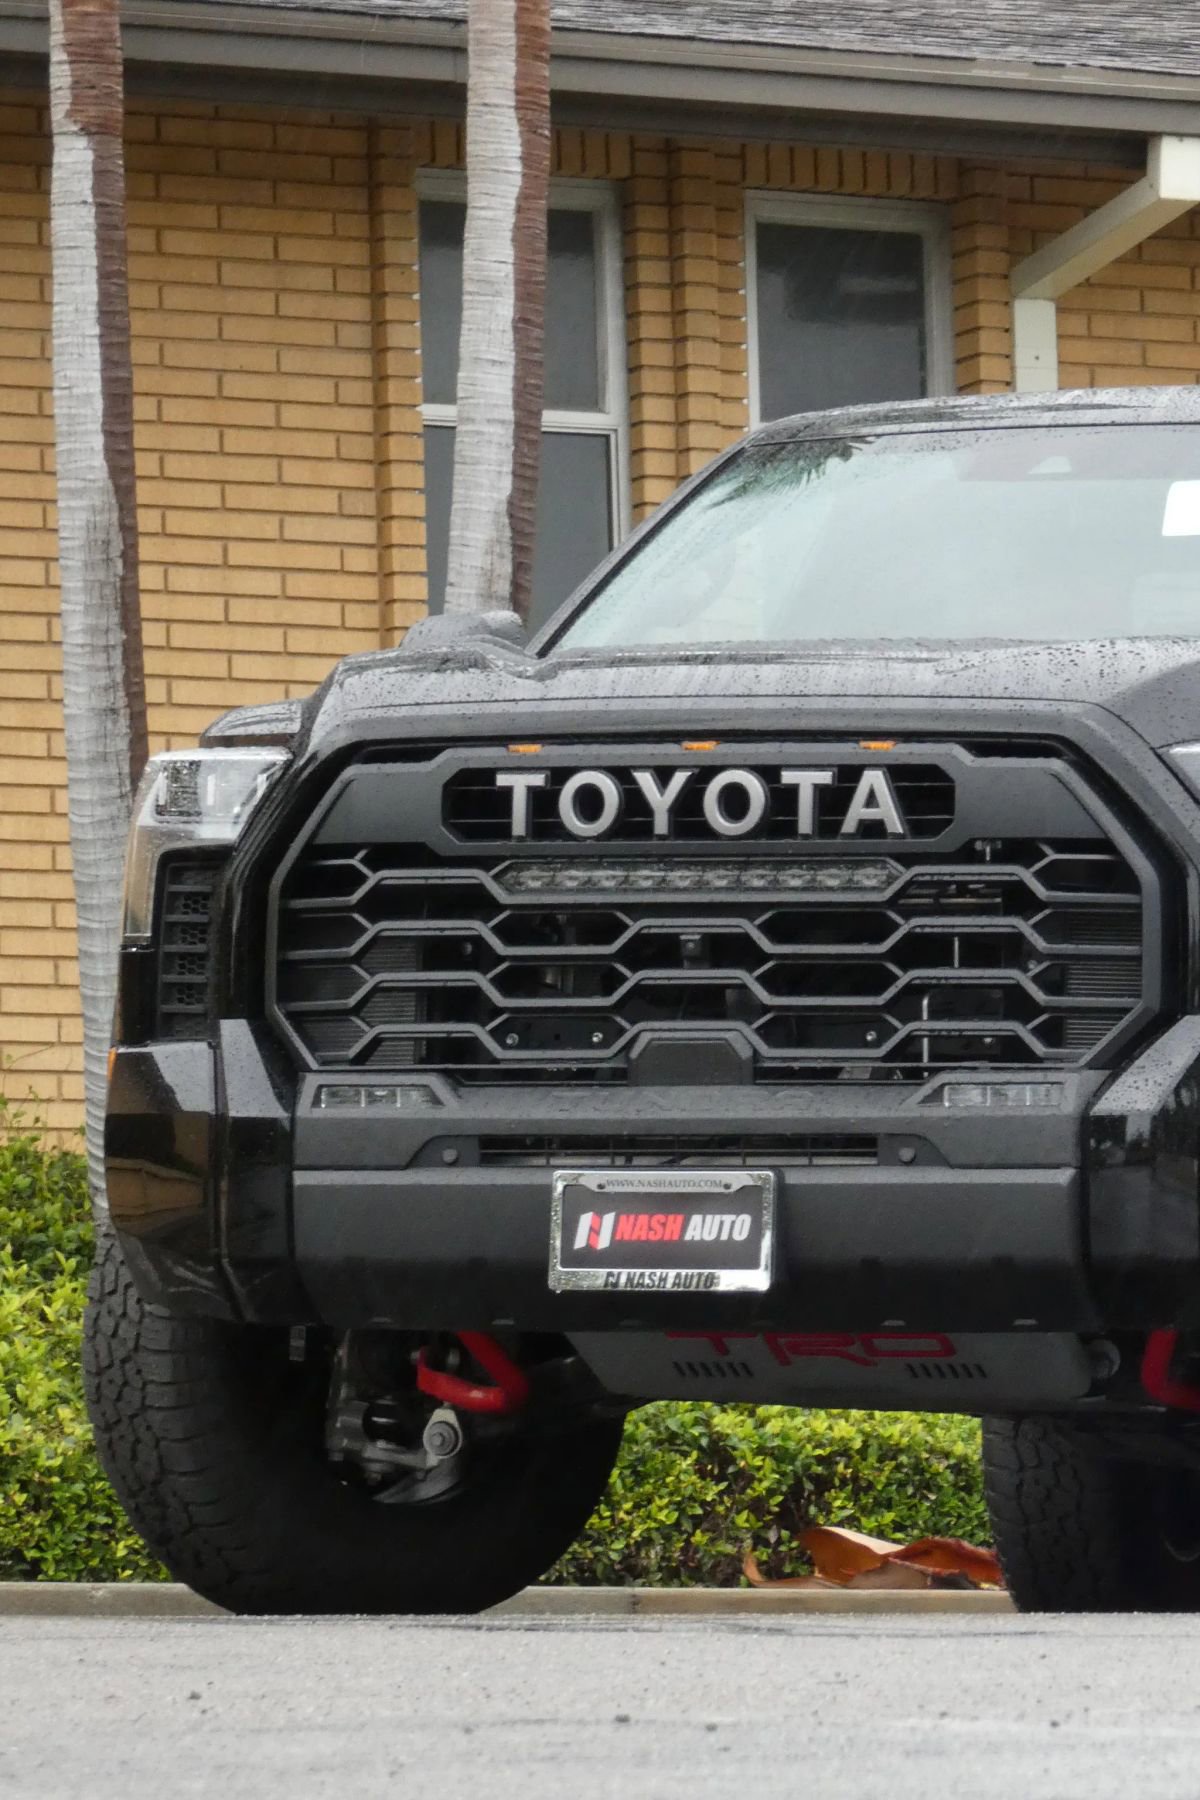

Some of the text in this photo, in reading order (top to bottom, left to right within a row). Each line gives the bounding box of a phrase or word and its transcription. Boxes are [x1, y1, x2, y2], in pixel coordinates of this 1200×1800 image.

[496, 769, 904, 838] TOYOTA
[606, 1179, 722, 1189] WWW.NASHAUTO.COM
[615, 1213, 685, 1241] NASH
[684, 1213, 751, 1241] AUTO
[625, 1271, 668, 1289] NASH
[671, 1271, 715, 1289] AUTO
